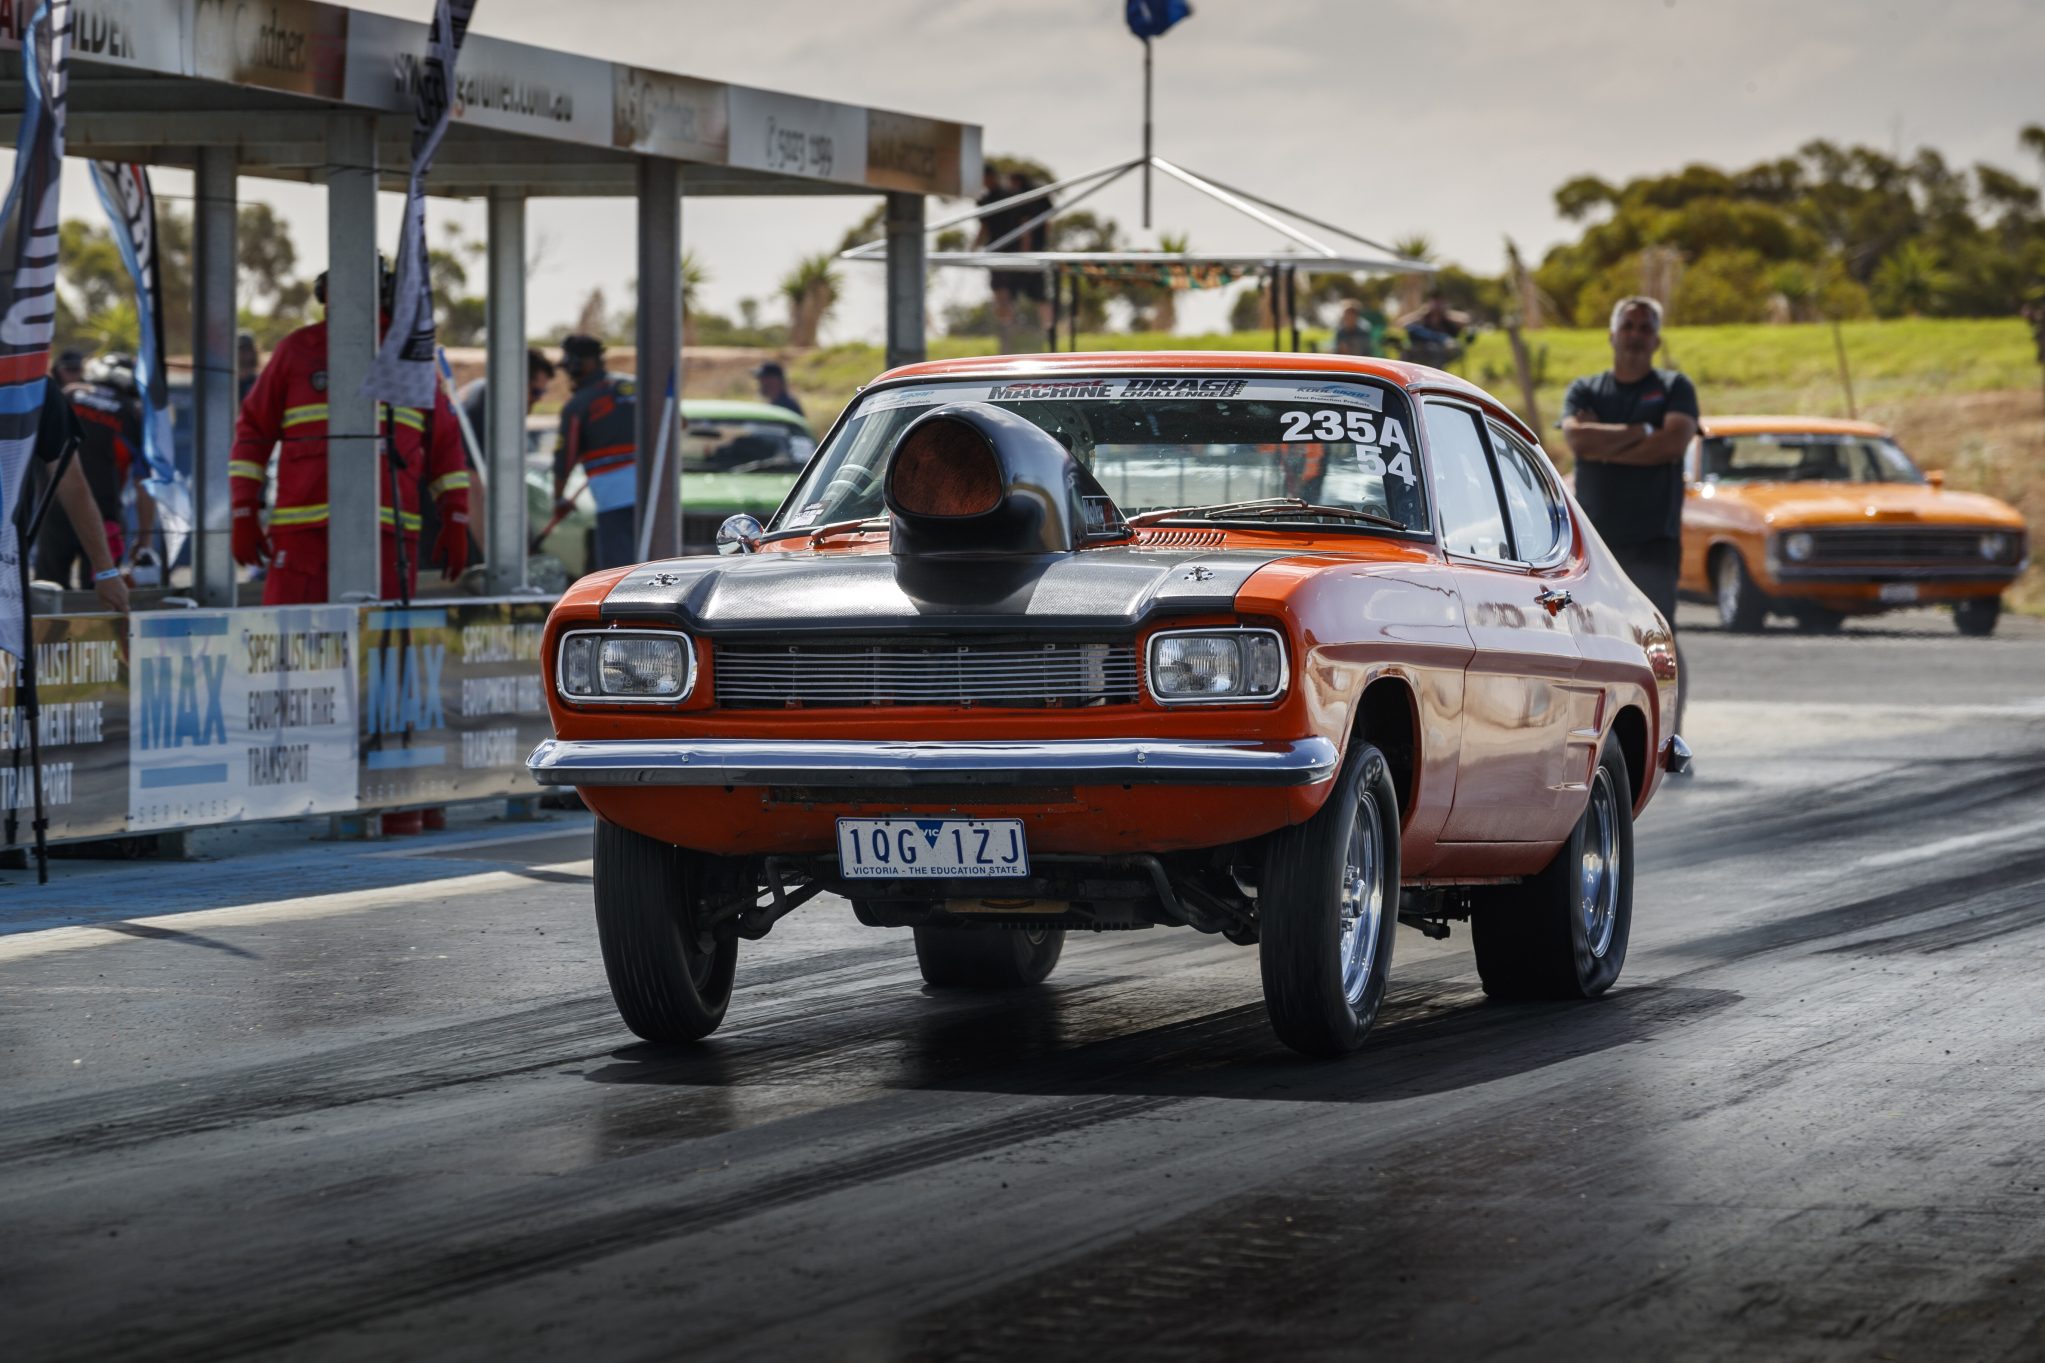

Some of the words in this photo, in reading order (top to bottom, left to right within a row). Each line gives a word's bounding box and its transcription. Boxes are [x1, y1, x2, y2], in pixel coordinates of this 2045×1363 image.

[988, 385, 1114, 399] MACHINE
[1124, 379, 1229, 391] DRAG
[1280, 410, 1411, 454] 235A
[1356, 444, 1416, 487] 54
[72, 640, 119, 684] LIFTING
[248, 632, 307, 674] SPECIALIST
[309, 631, 348, 670] LIFTING
[140, 654, 228, 750] MAX
[248, 688, 309, 730] EQUIPMENT
[311, 686, 335, 725] HIRE
[367, 644, 446, 734] MAX
[74, 701, 104, 744] HIRE
[0, 762, 73, 810] TRANPORT
[248, 744, 310, 786] TRANSPORT
[850, 828, 917, 865] 1QG
[951, 828, 1019, 865] 1ZJ
[853, 867, 899, 875] VICTORIA
[908, 867, 928, 875] THE
[930, 866, 986, 875] EDUCATION
[988, 866, 1018, 874] STATE
